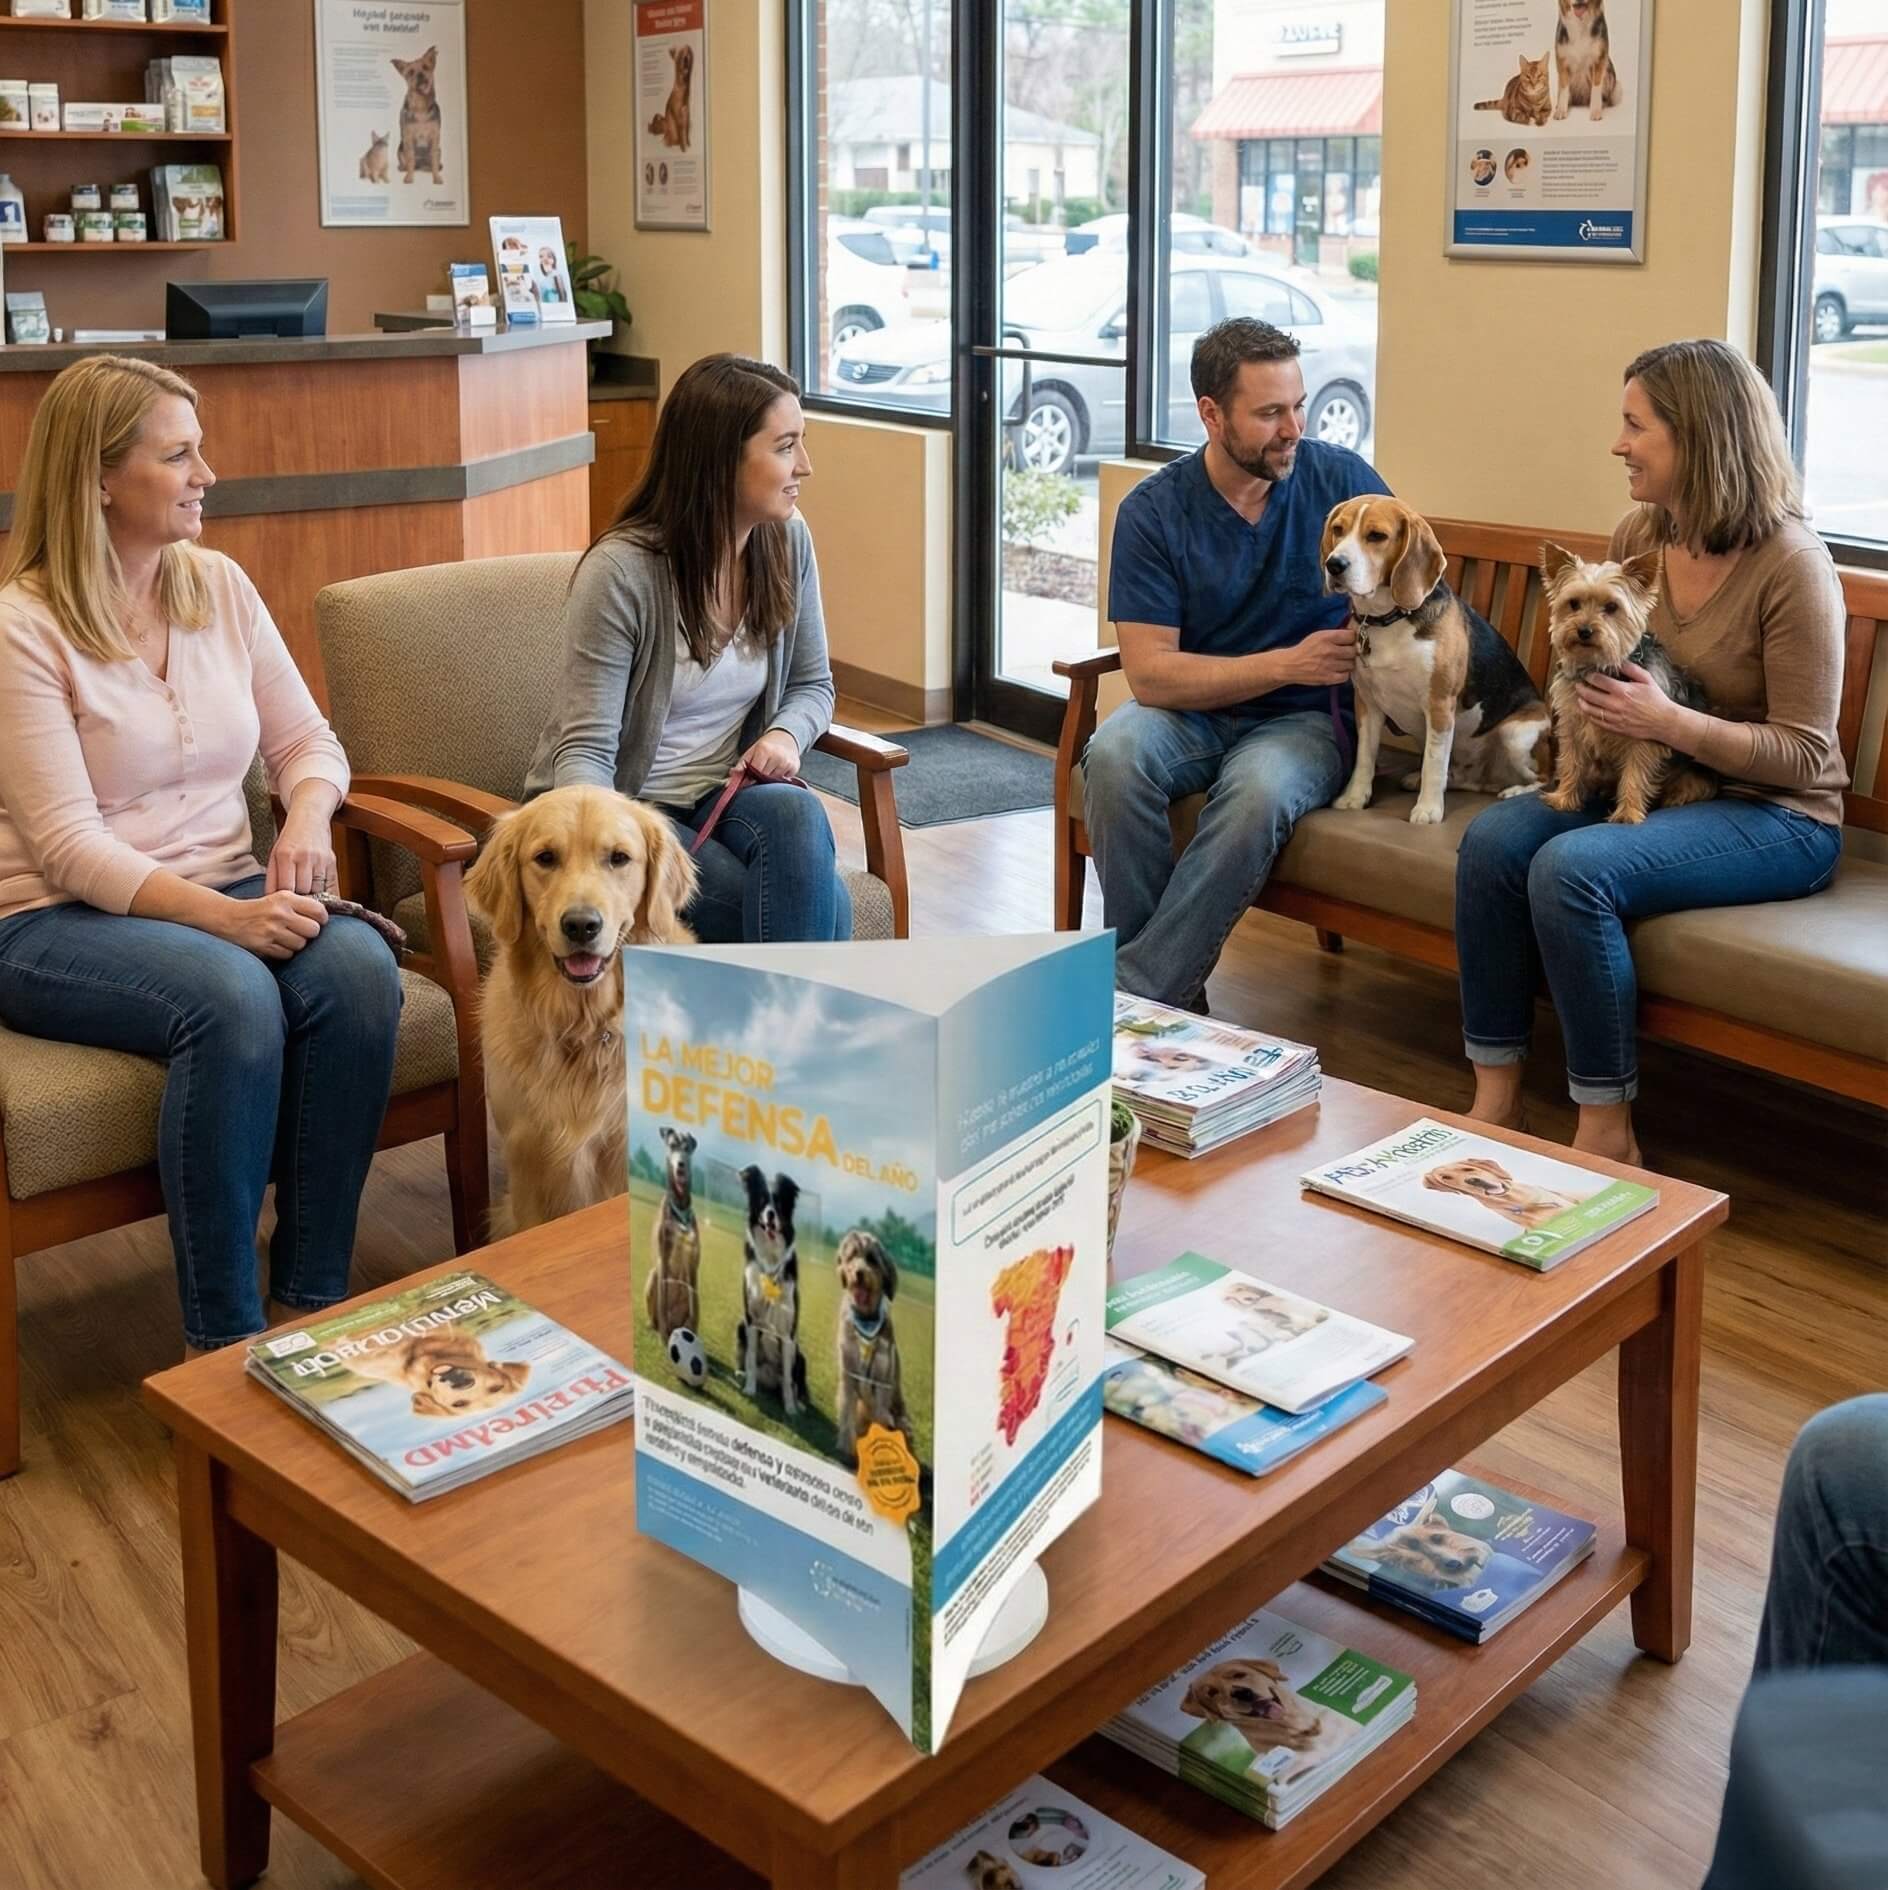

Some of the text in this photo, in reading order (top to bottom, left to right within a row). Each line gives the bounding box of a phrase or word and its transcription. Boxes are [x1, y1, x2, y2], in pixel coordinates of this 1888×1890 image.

[640, 1031, 776, 1091] LA MEJOR
[640, 1067, 919, 1192] DEFENSA DEL AÑO
